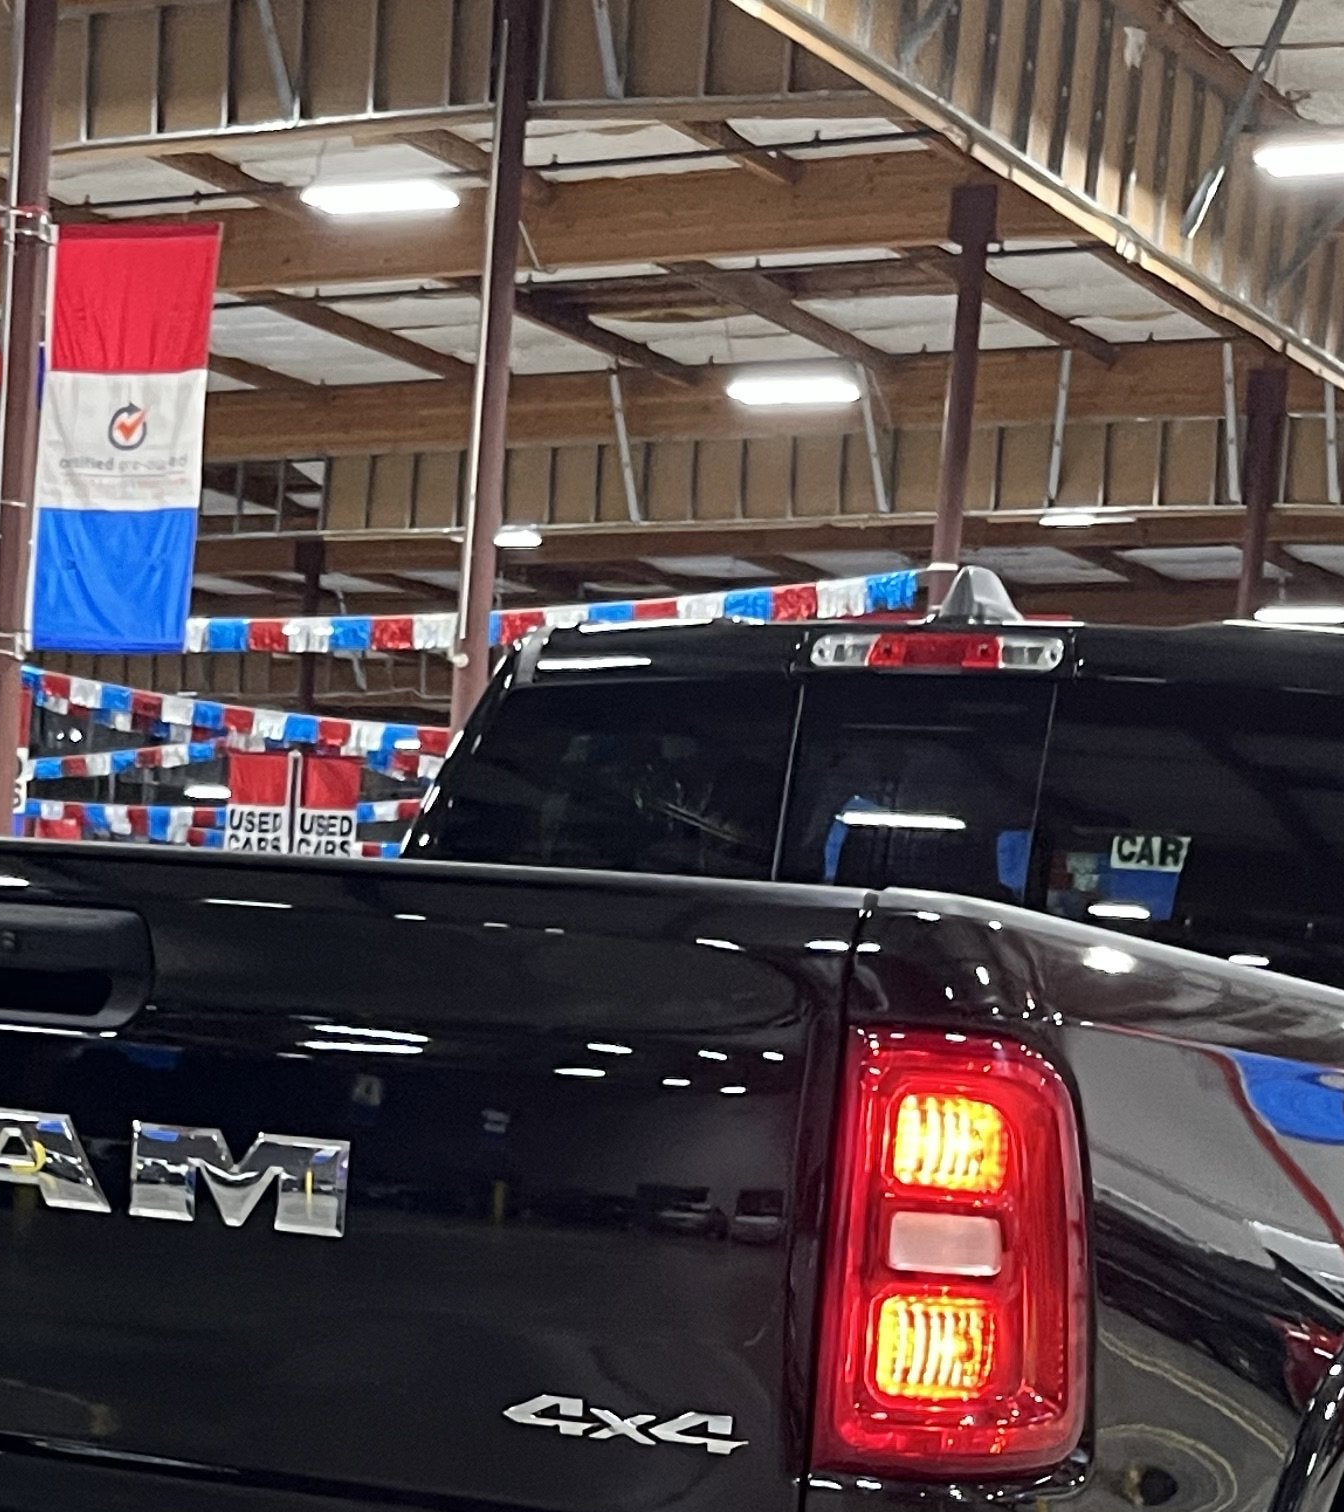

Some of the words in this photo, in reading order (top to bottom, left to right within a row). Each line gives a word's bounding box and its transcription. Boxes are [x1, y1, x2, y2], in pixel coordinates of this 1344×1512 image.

[229, 808, 283, 833] USED
[300, 812, 353, 837] USED
[503, 1394, 749, 1454] 4x4
